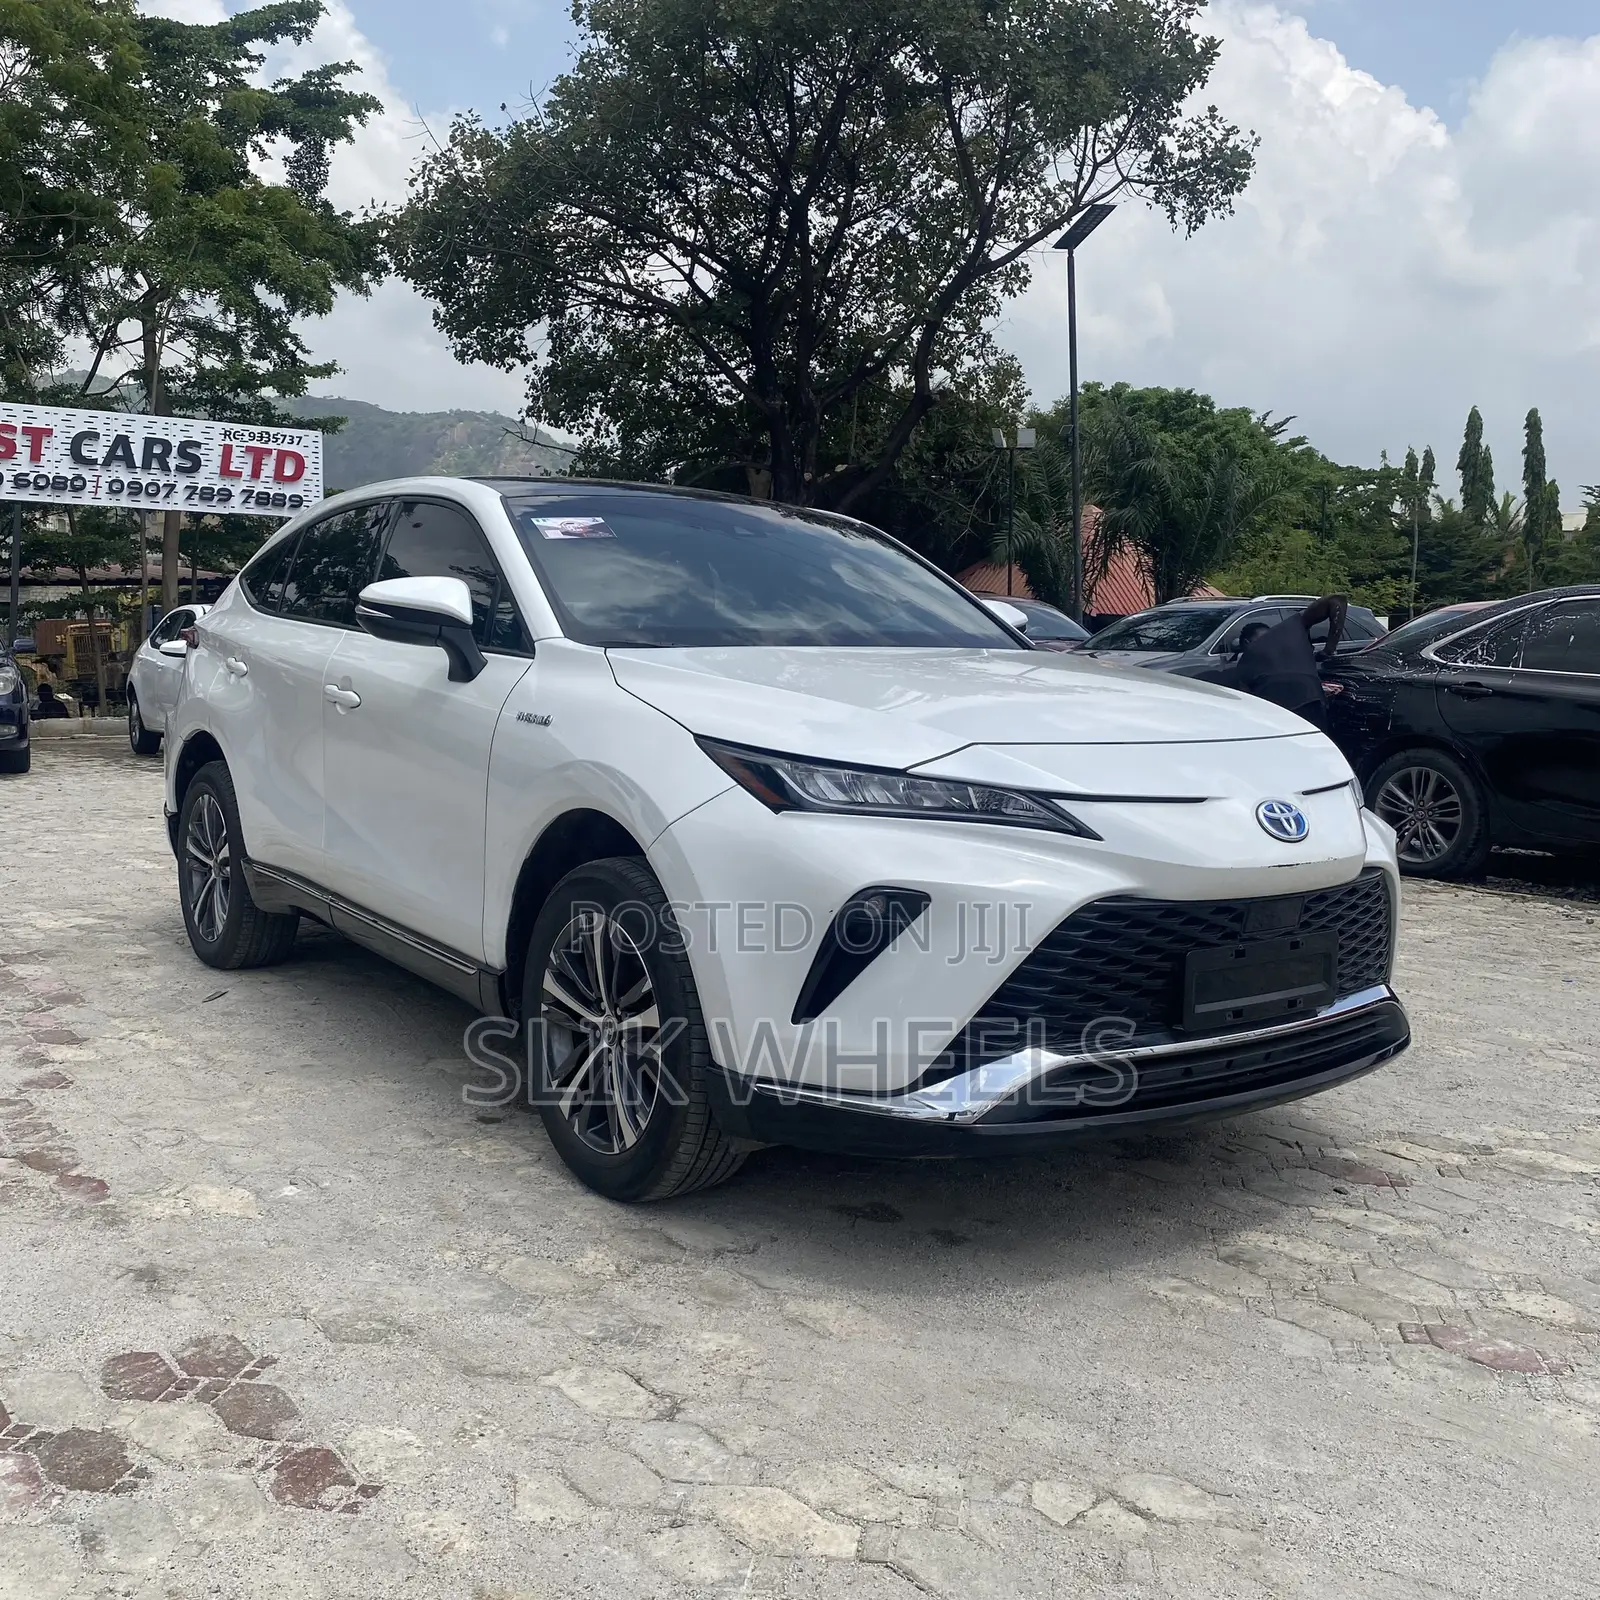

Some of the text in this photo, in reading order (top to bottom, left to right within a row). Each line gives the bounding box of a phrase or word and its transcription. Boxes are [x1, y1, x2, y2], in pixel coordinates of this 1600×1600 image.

[0, 423, 305, 482] ST CARS LTD
[13, 472, 87, 491] 6080
[108, 478, 176, 499] 0907
[183, 484, 233, 502] 789
[240, 489, 304, 508] 7889
